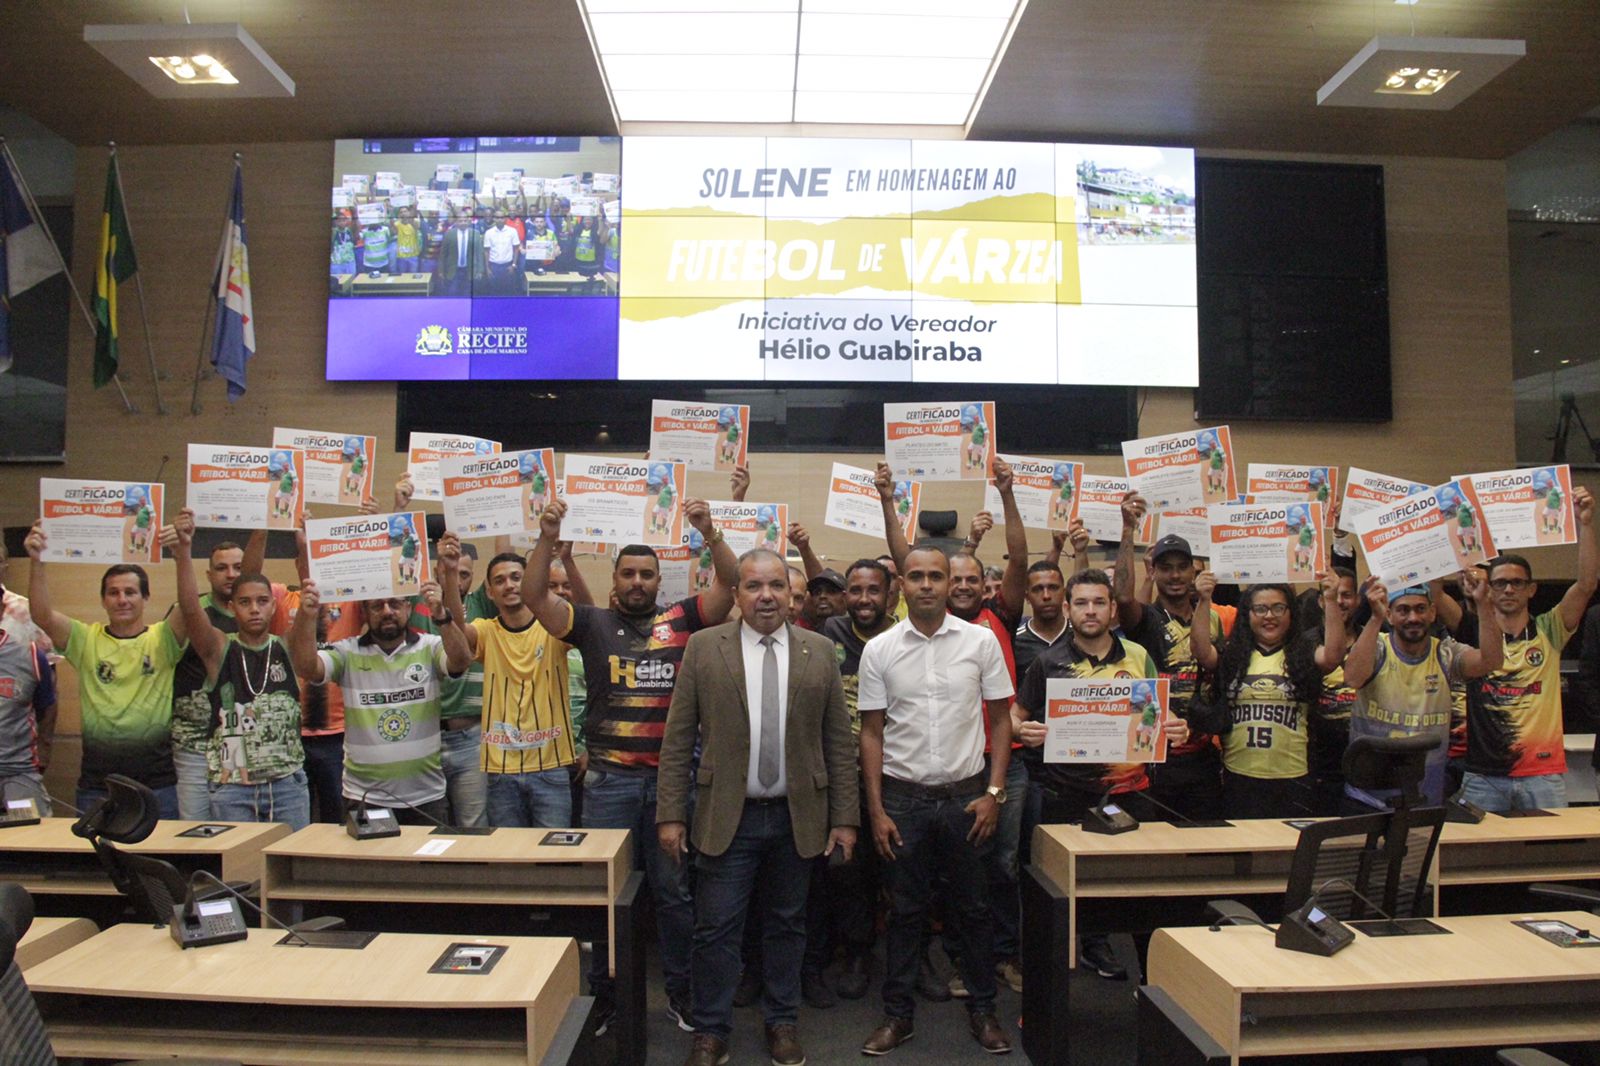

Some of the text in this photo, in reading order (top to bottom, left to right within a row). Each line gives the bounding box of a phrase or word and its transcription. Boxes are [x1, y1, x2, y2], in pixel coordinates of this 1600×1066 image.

[699, 167, 1017, 198] SOLENE EM HOMENAGEM AO
[666, 227, 1063, 285] FUTEBOL DE VÁRZEA
[737, 311, 998, 334] Iniciativa do Vereador
[458, 333, 528, 348] RECIFE
[758, 338, 983, 362] Hélio Guabiraba
[1230, 510, 1286, 523] CERTIFICADO
[1378, 496, 1437, 526] CERTIFICADO
[330, 521, 388, 537] CERTIFICADO
[608, 655, 675, 688] Hélio
[635, 680, 673, 688] Guabiraba
[1070, 686, 1131, 697] CERTIFICADO
[360, 687, 426, 705] BESTGAME
[225, 712, 238, 729] 10
[1367, 700, 1400, 724] BOLA
[1404, 714, 1420, 727] DE
[525, 726, 561, 743] GOMES
[1246, 726, 1273, 748] 15
